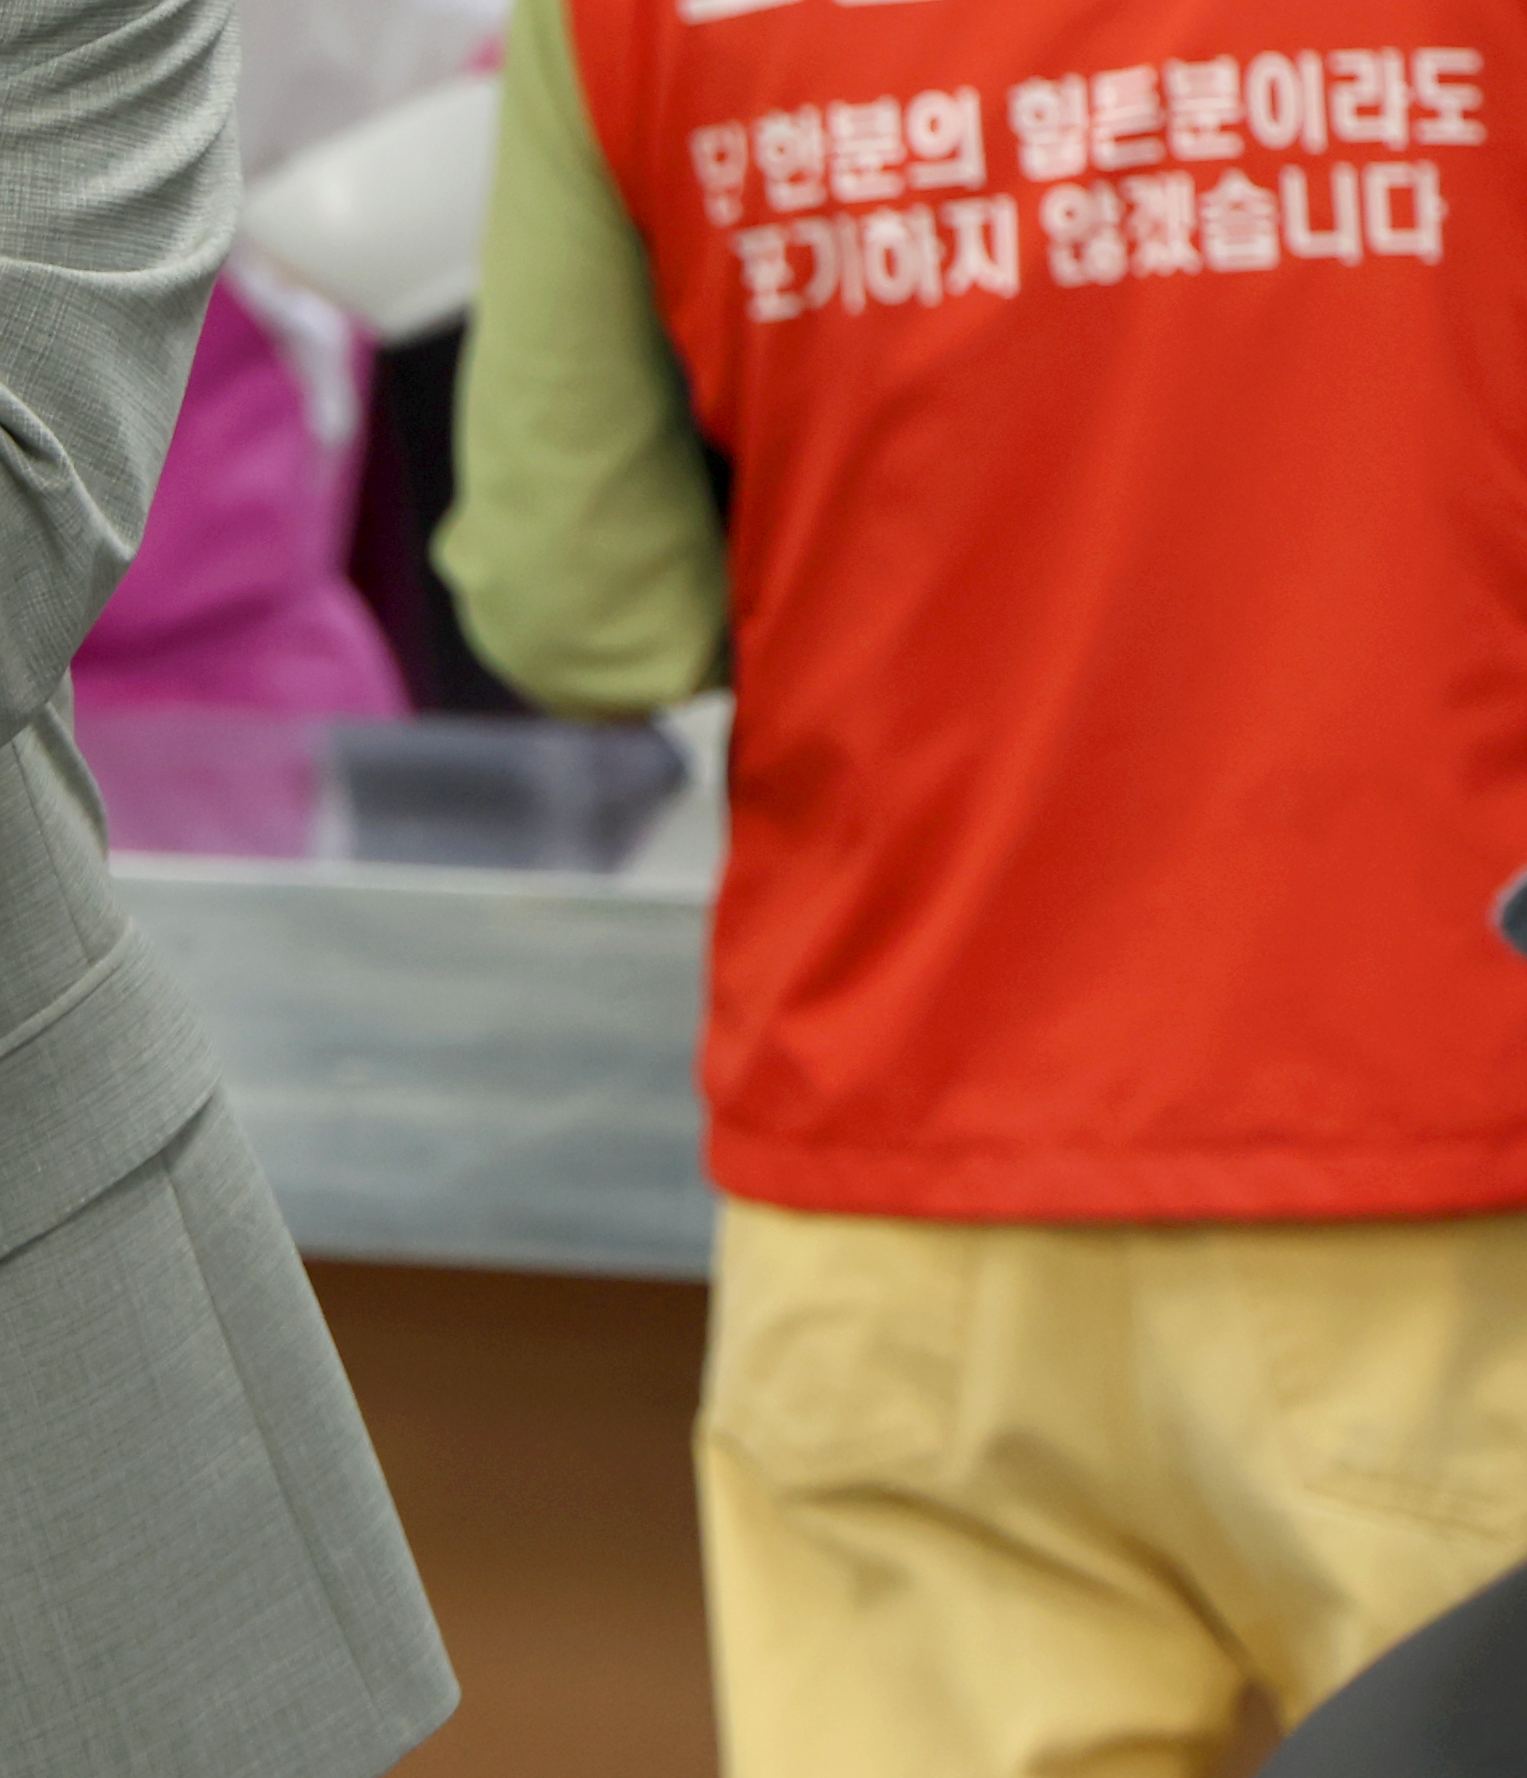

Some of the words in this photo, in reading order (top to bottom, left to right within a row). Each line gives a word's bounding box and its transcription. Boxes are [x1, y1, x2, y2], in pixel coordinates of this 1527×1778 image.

[1007, 46, 1488, 182] 힘든분이라도
[731, 192, 1021, 324] 포기하지
[1040, 158, 1450, 288] 않겠습니다
